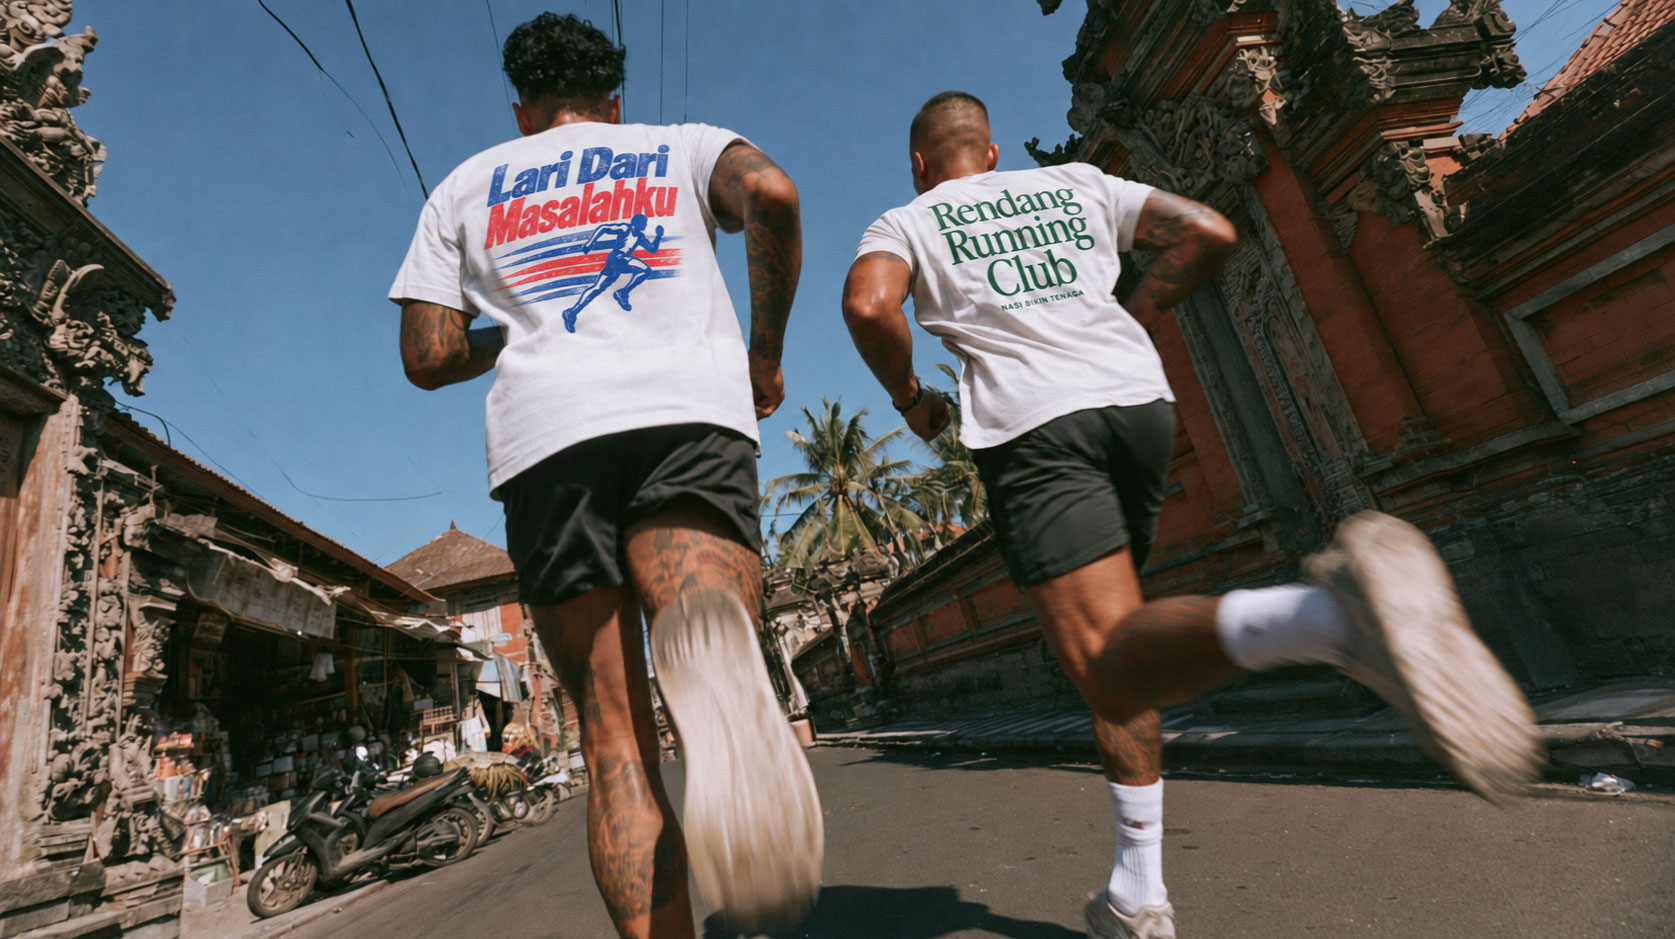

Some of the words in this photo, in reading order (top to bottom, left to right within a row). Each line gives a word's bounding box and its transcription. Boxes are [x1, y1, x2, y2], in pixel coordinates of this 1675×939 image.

[487, 150, 573, 207] Lari
[577, 143, 670, 185] Dari
[484, 177, 679, 249] Masalahku
[928, 188, 1083, 231] Rendang
[941, 215, 1095, 265] Running
[987, 249, 1077, 296] Club
[1001, 301, 1023, 311] NASI
[1025, 296, 1049, 307] BIKIN
[1050, 289, 1084, 302] TENAGA
